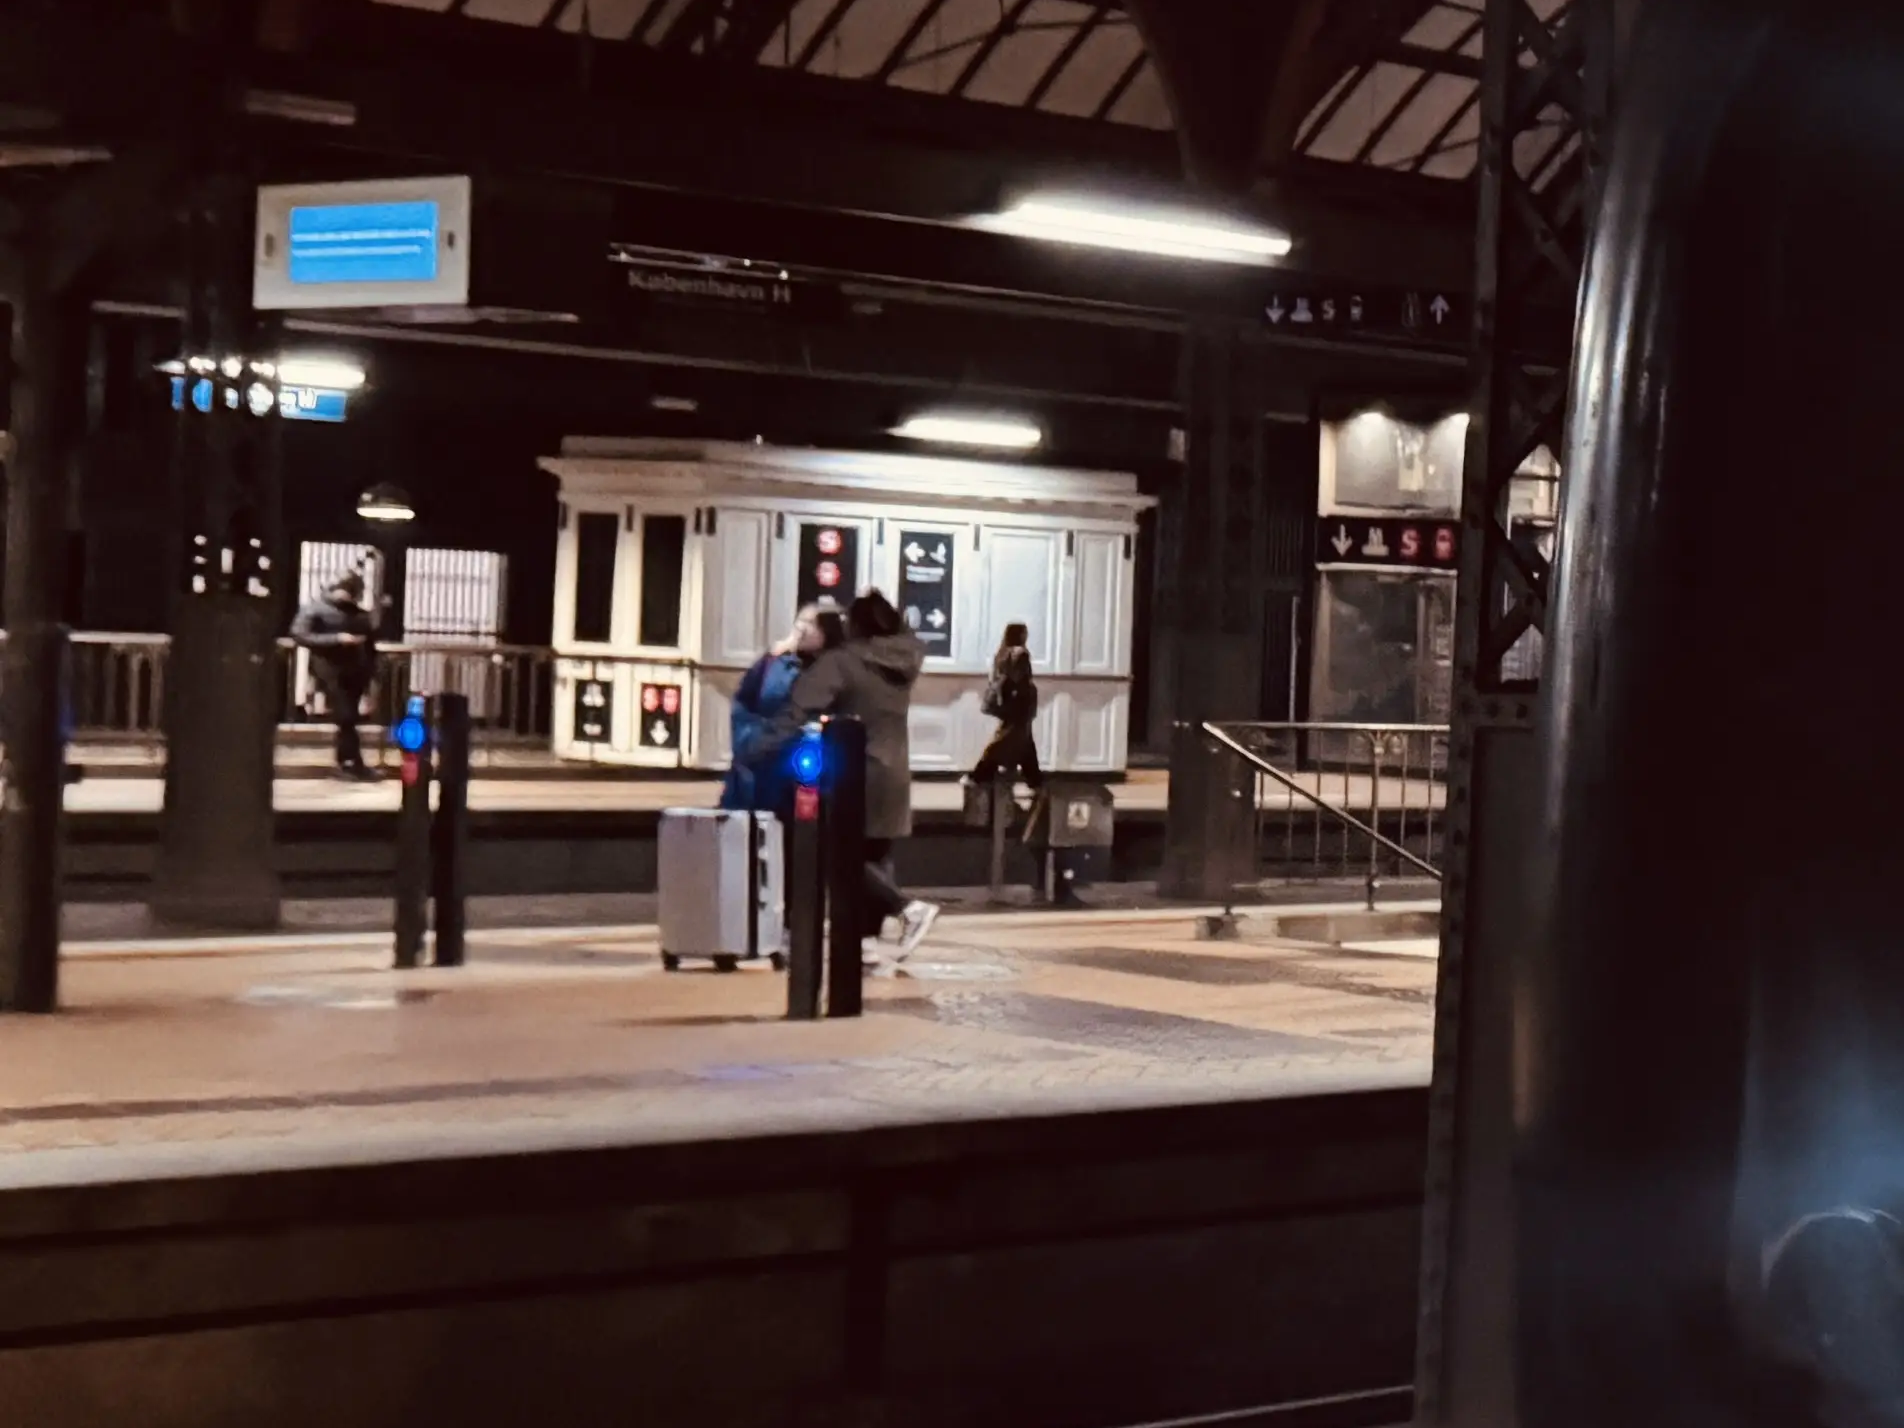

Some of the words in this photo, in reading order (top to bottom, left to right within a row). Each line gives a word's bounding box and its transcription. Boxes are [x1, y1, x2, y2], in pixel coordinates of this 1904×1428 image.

[627, 268, 767, 301] København
[771, 283, 793, 304] H
[1400, 529, 1421, 558] S
